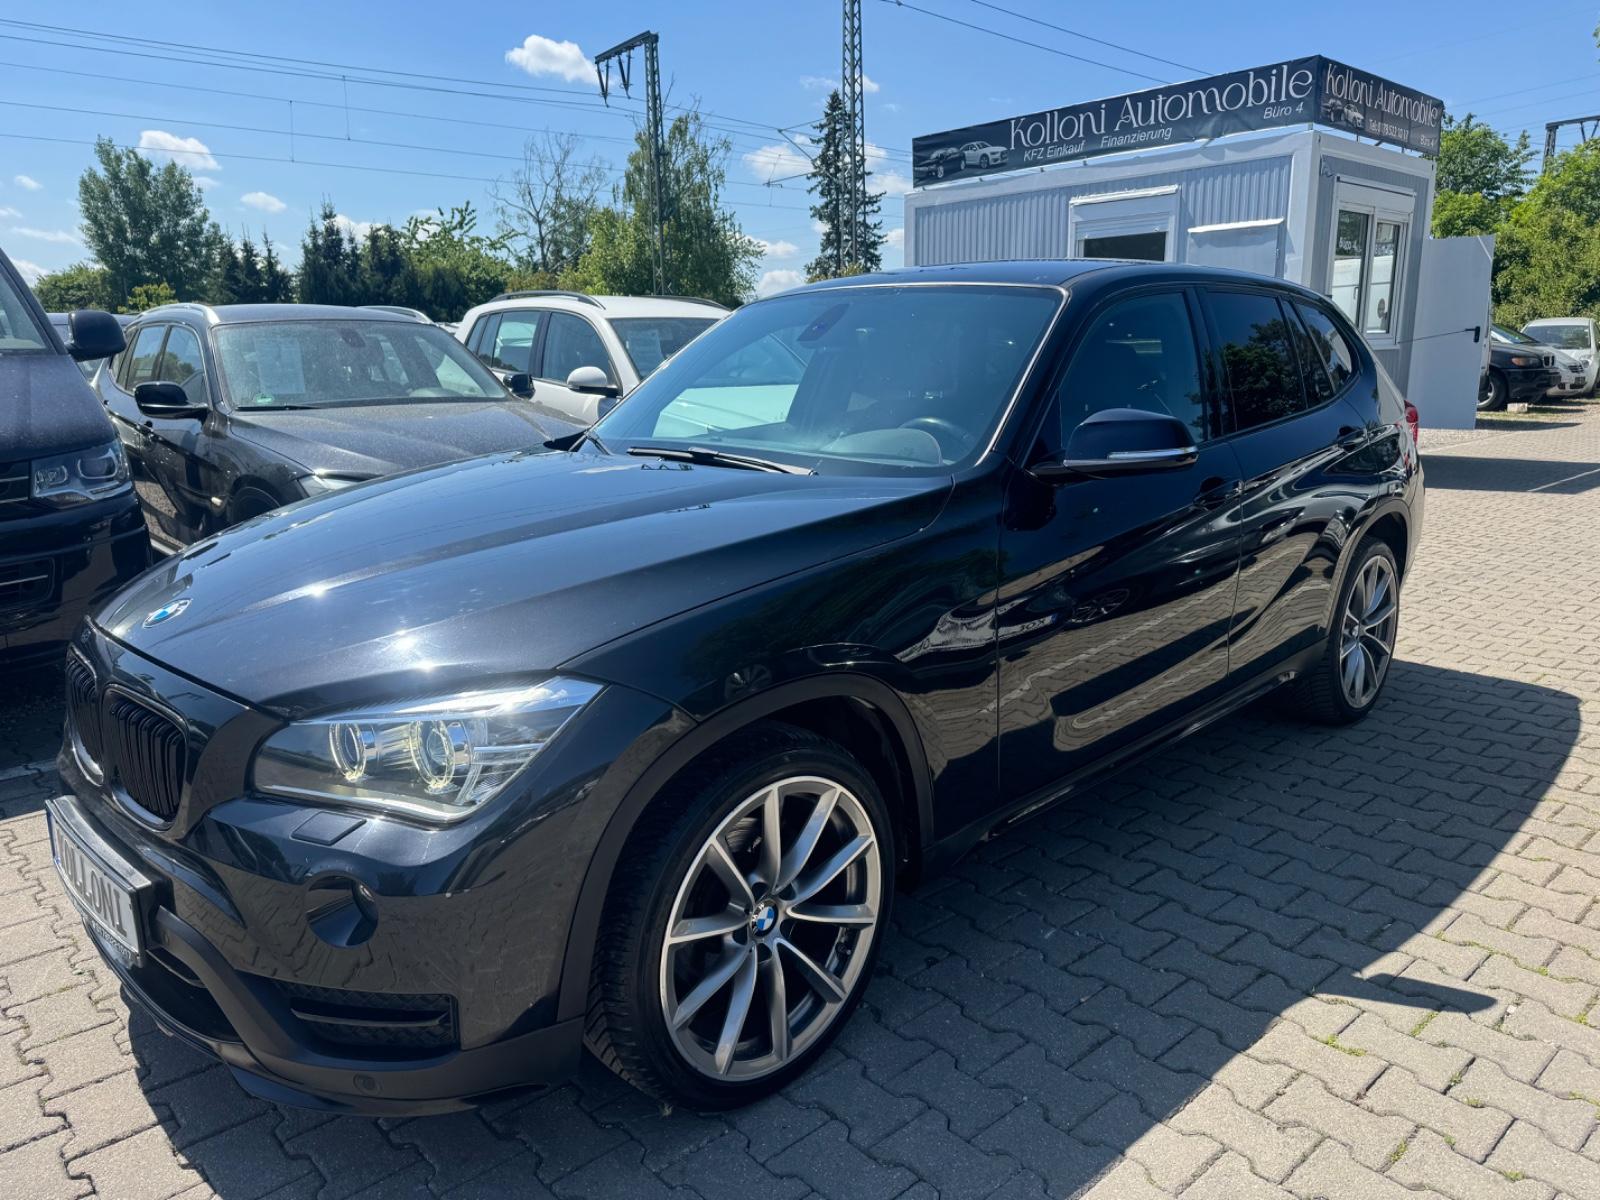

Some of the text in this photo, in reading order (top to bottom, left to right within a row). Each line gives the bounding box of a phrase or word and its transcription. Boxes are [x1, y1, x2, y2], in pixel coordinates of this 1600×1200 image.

[1010, 103, 1105, 150] Kolloni
[1113, 64, 1313, 131] Automobile
[1263, 101, 1304, 119] Büro 4
[1325, 63, 1438, 127] Kolloni Automobile
[1023, 127, 1173, 162] KFZ Einkauf Finanzierung
